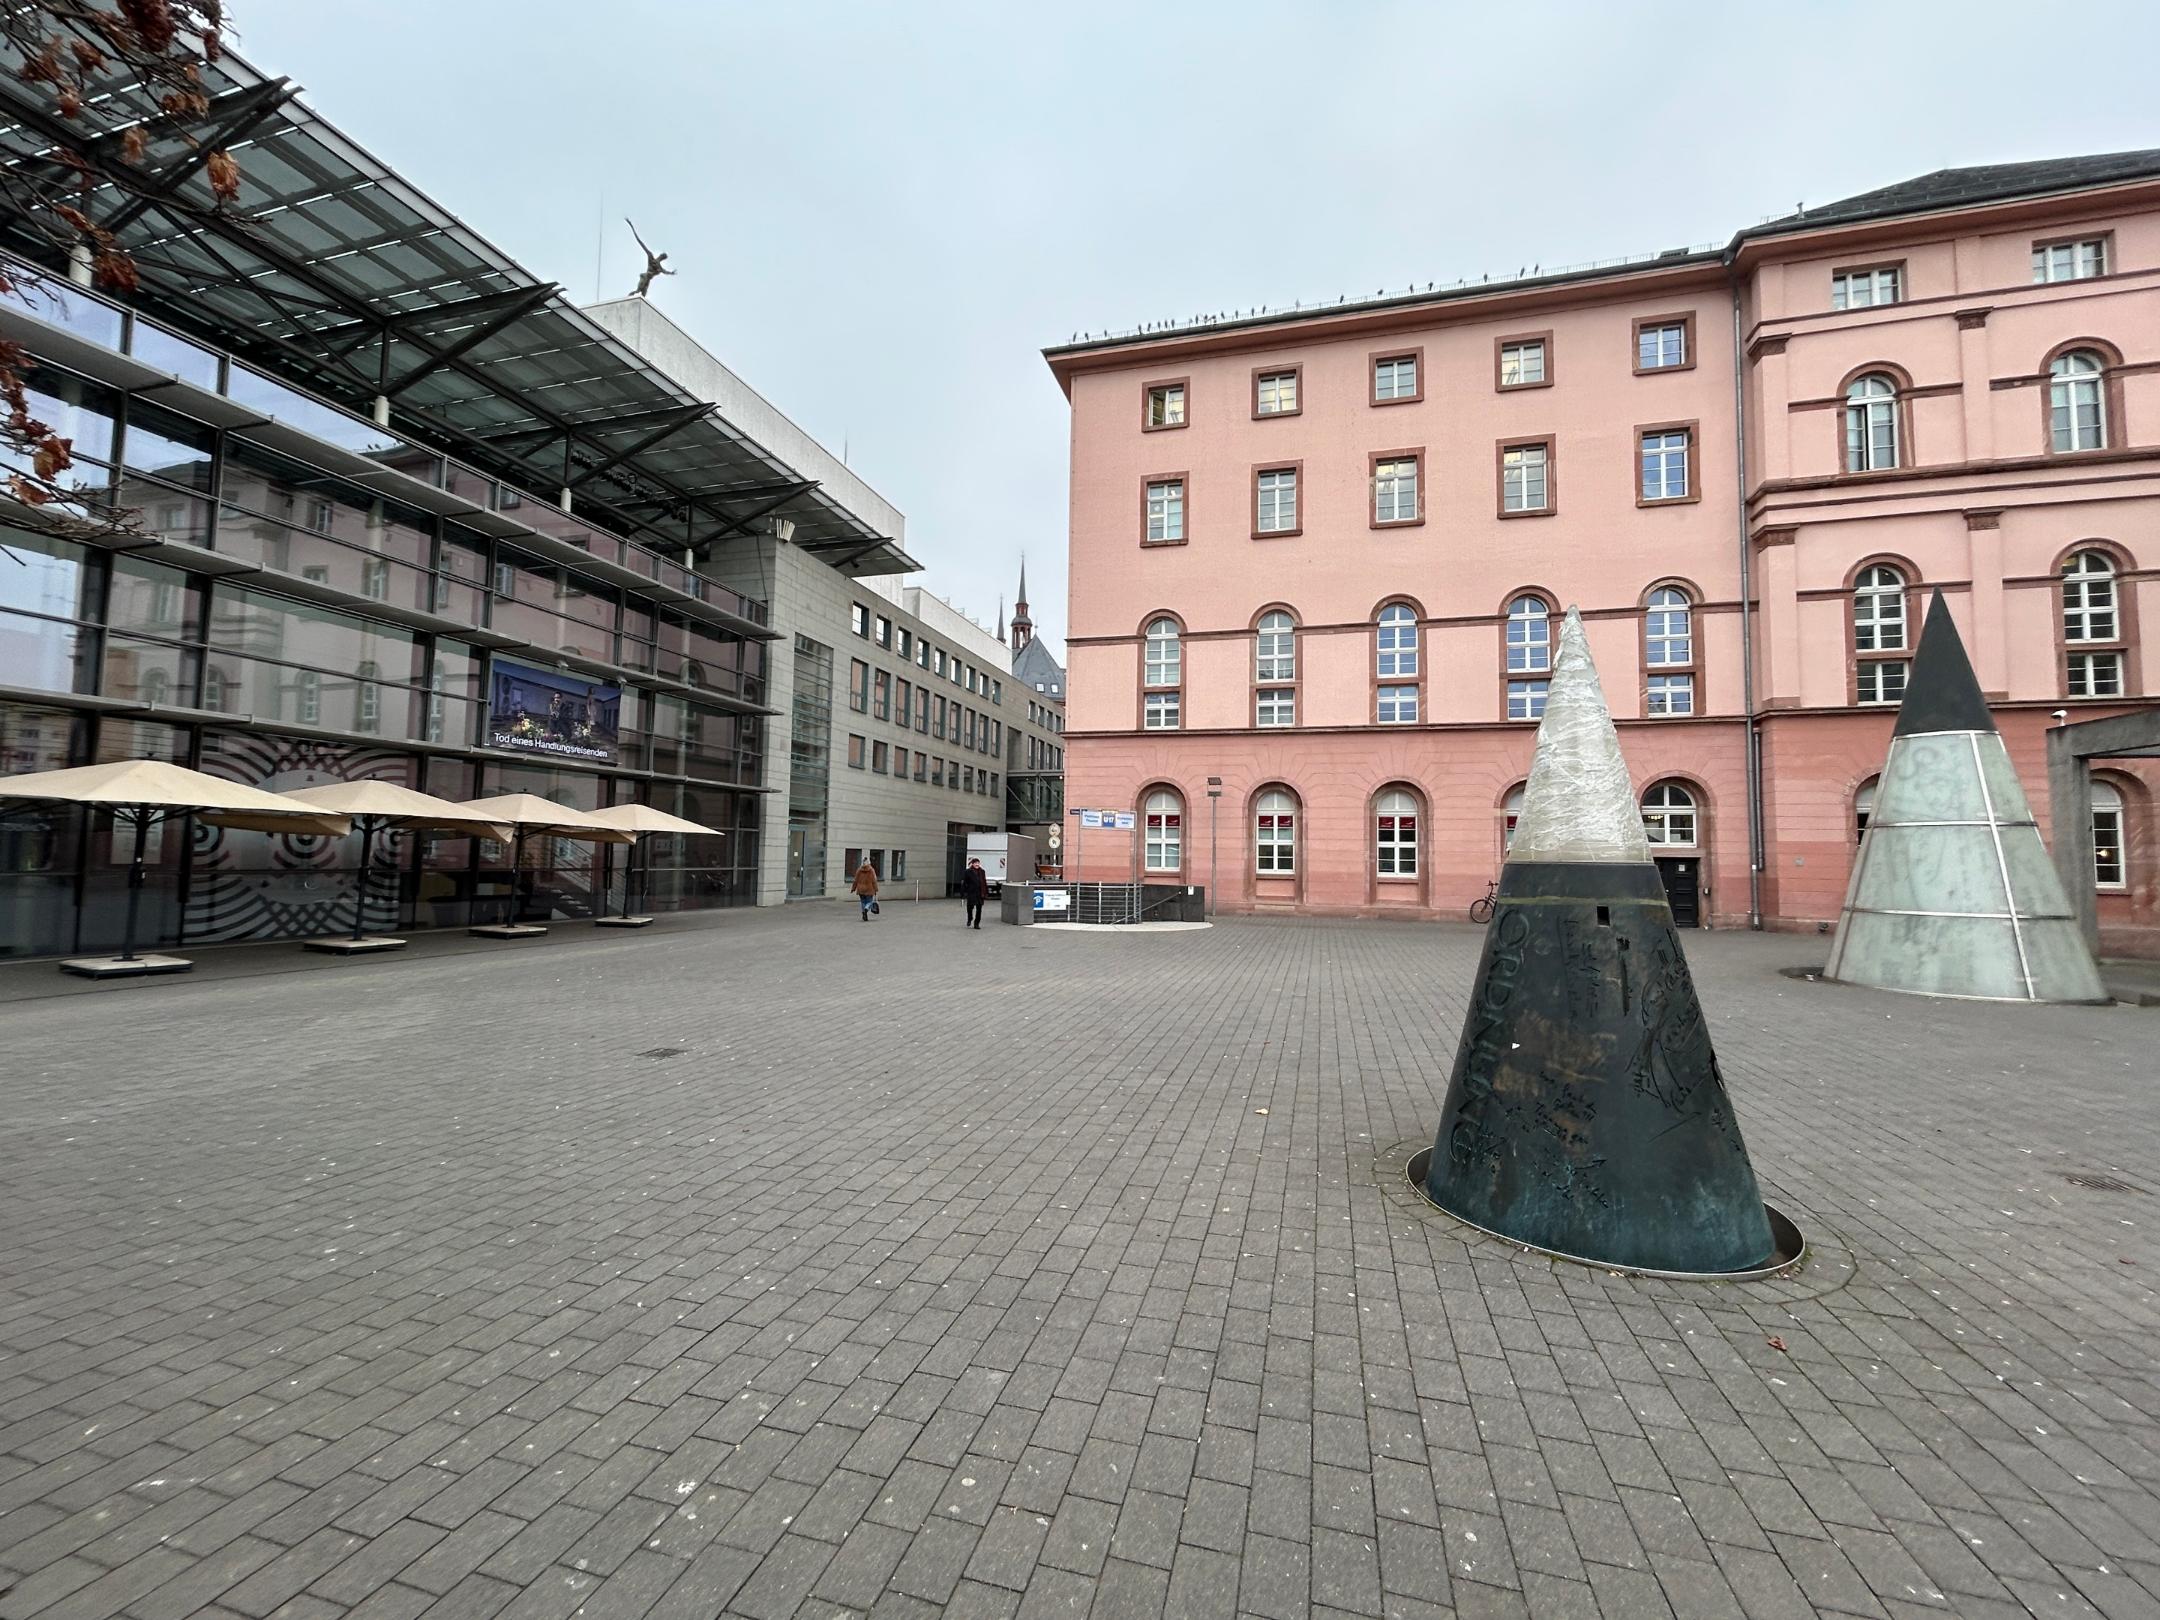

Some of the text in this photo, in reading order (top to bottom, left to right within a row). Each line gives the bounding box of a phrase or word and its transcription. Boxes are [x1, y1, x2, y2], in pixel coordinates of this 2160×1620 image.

[494, 732, 609, 758] Tod eines Handlungsreisenden
